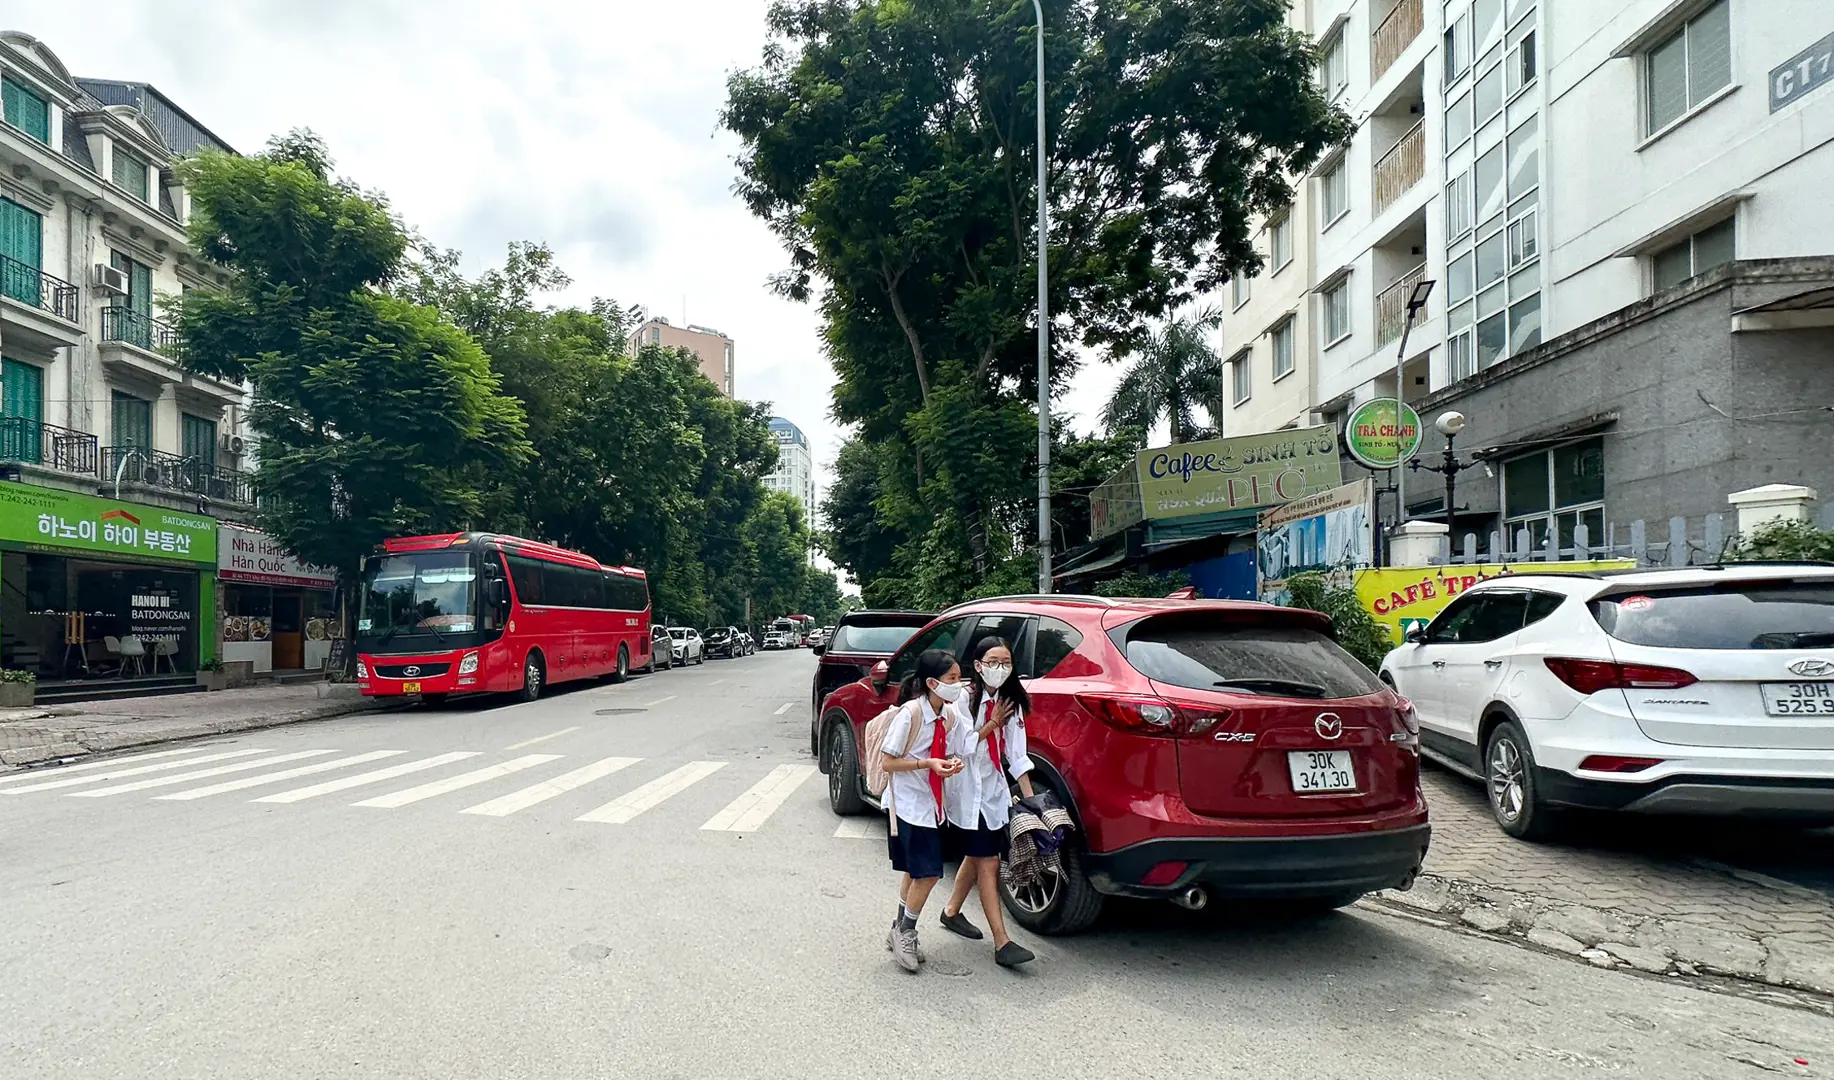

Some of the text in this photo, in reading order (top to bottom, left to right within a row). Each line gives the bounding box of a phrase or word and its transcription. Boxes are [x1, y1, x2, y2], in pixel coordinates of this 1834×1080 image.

[1776, 52, 1832, 99] CT7
[1242, 428, 1334, 464] SINH TỐ
[1149, 451, 1220, 483] Cafee
[1227, 461, 1307, 507] PHỞ
[162, 515, 211, 531] BATDONGSAN
[38, 513, 191, 554] 하노이 하이 부동산
[232, 538, 287, 560] Nhà Hàng
[232, 555, 254, 570] Hàn
[258, 556, 286, 573] Quốc
[131, 594, 170, 608] HANOI HI
[131, 609, 191, 620] BATDONGSAN
[1788, 684, 1830, 698] 30H
[1214, 732, 1257, 742] CX-5
[1307, 752, 1336, 770] 30K
[1299, 770, 1350, 789] 341.30
